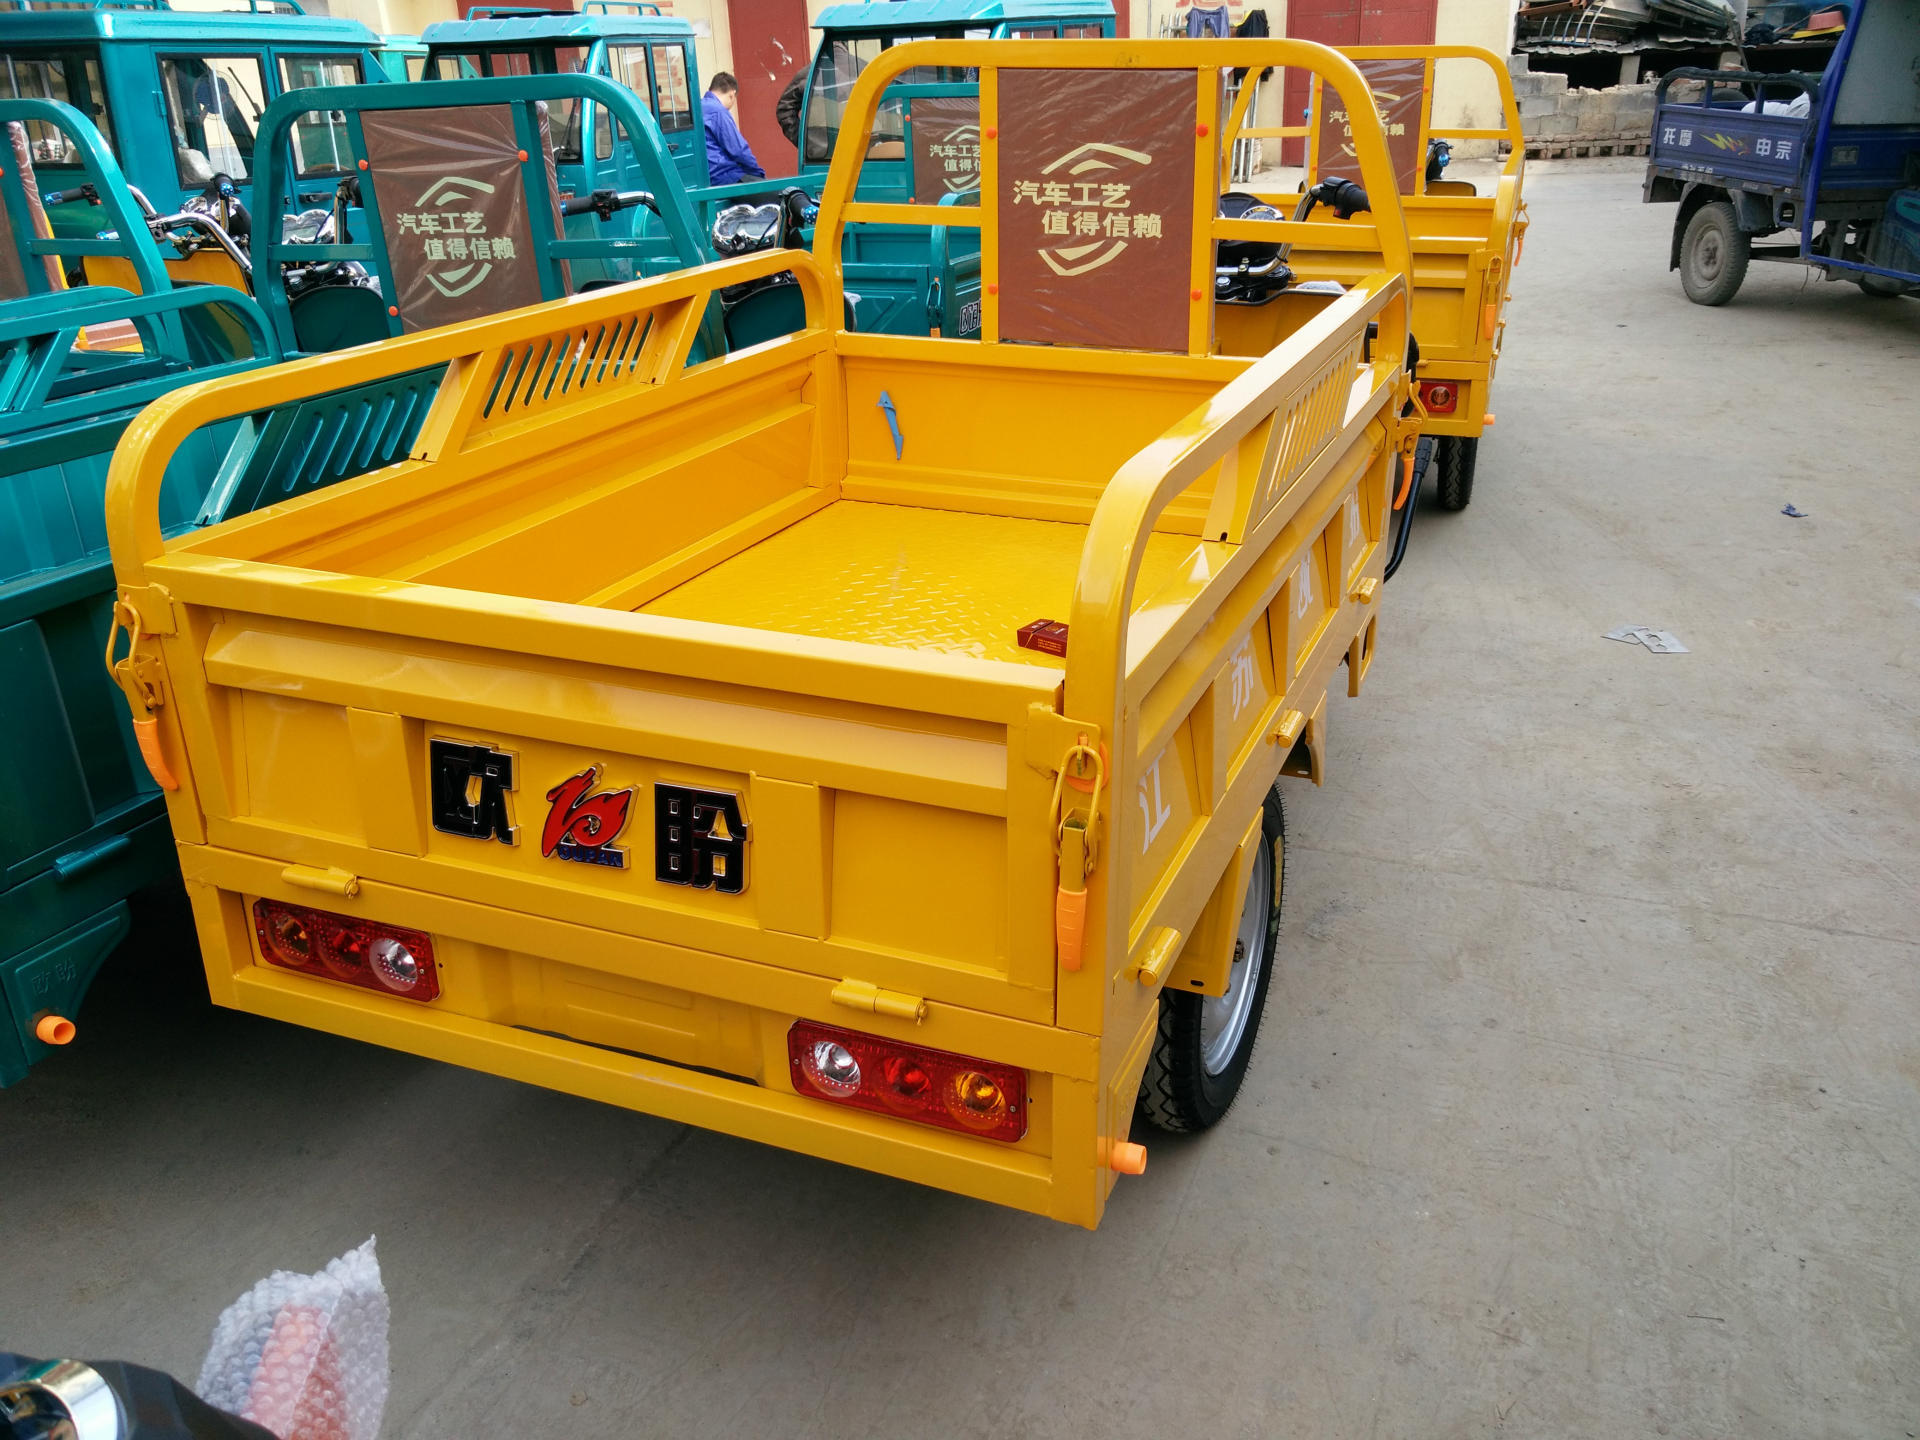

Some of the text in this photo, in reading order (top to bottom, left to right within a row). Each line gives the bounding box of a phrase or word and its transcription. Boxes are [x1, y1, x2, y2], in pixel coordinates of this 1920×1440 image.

[1013, 180, 1131, 208] 汽车工艺
[396, 211, 487, 235] 汽车工艺
[1042, 210, 1163, 239] 值得信赖
[423, 236, 516, 260] 值得信赖
[558, 845, 623, 868] OUPAN
